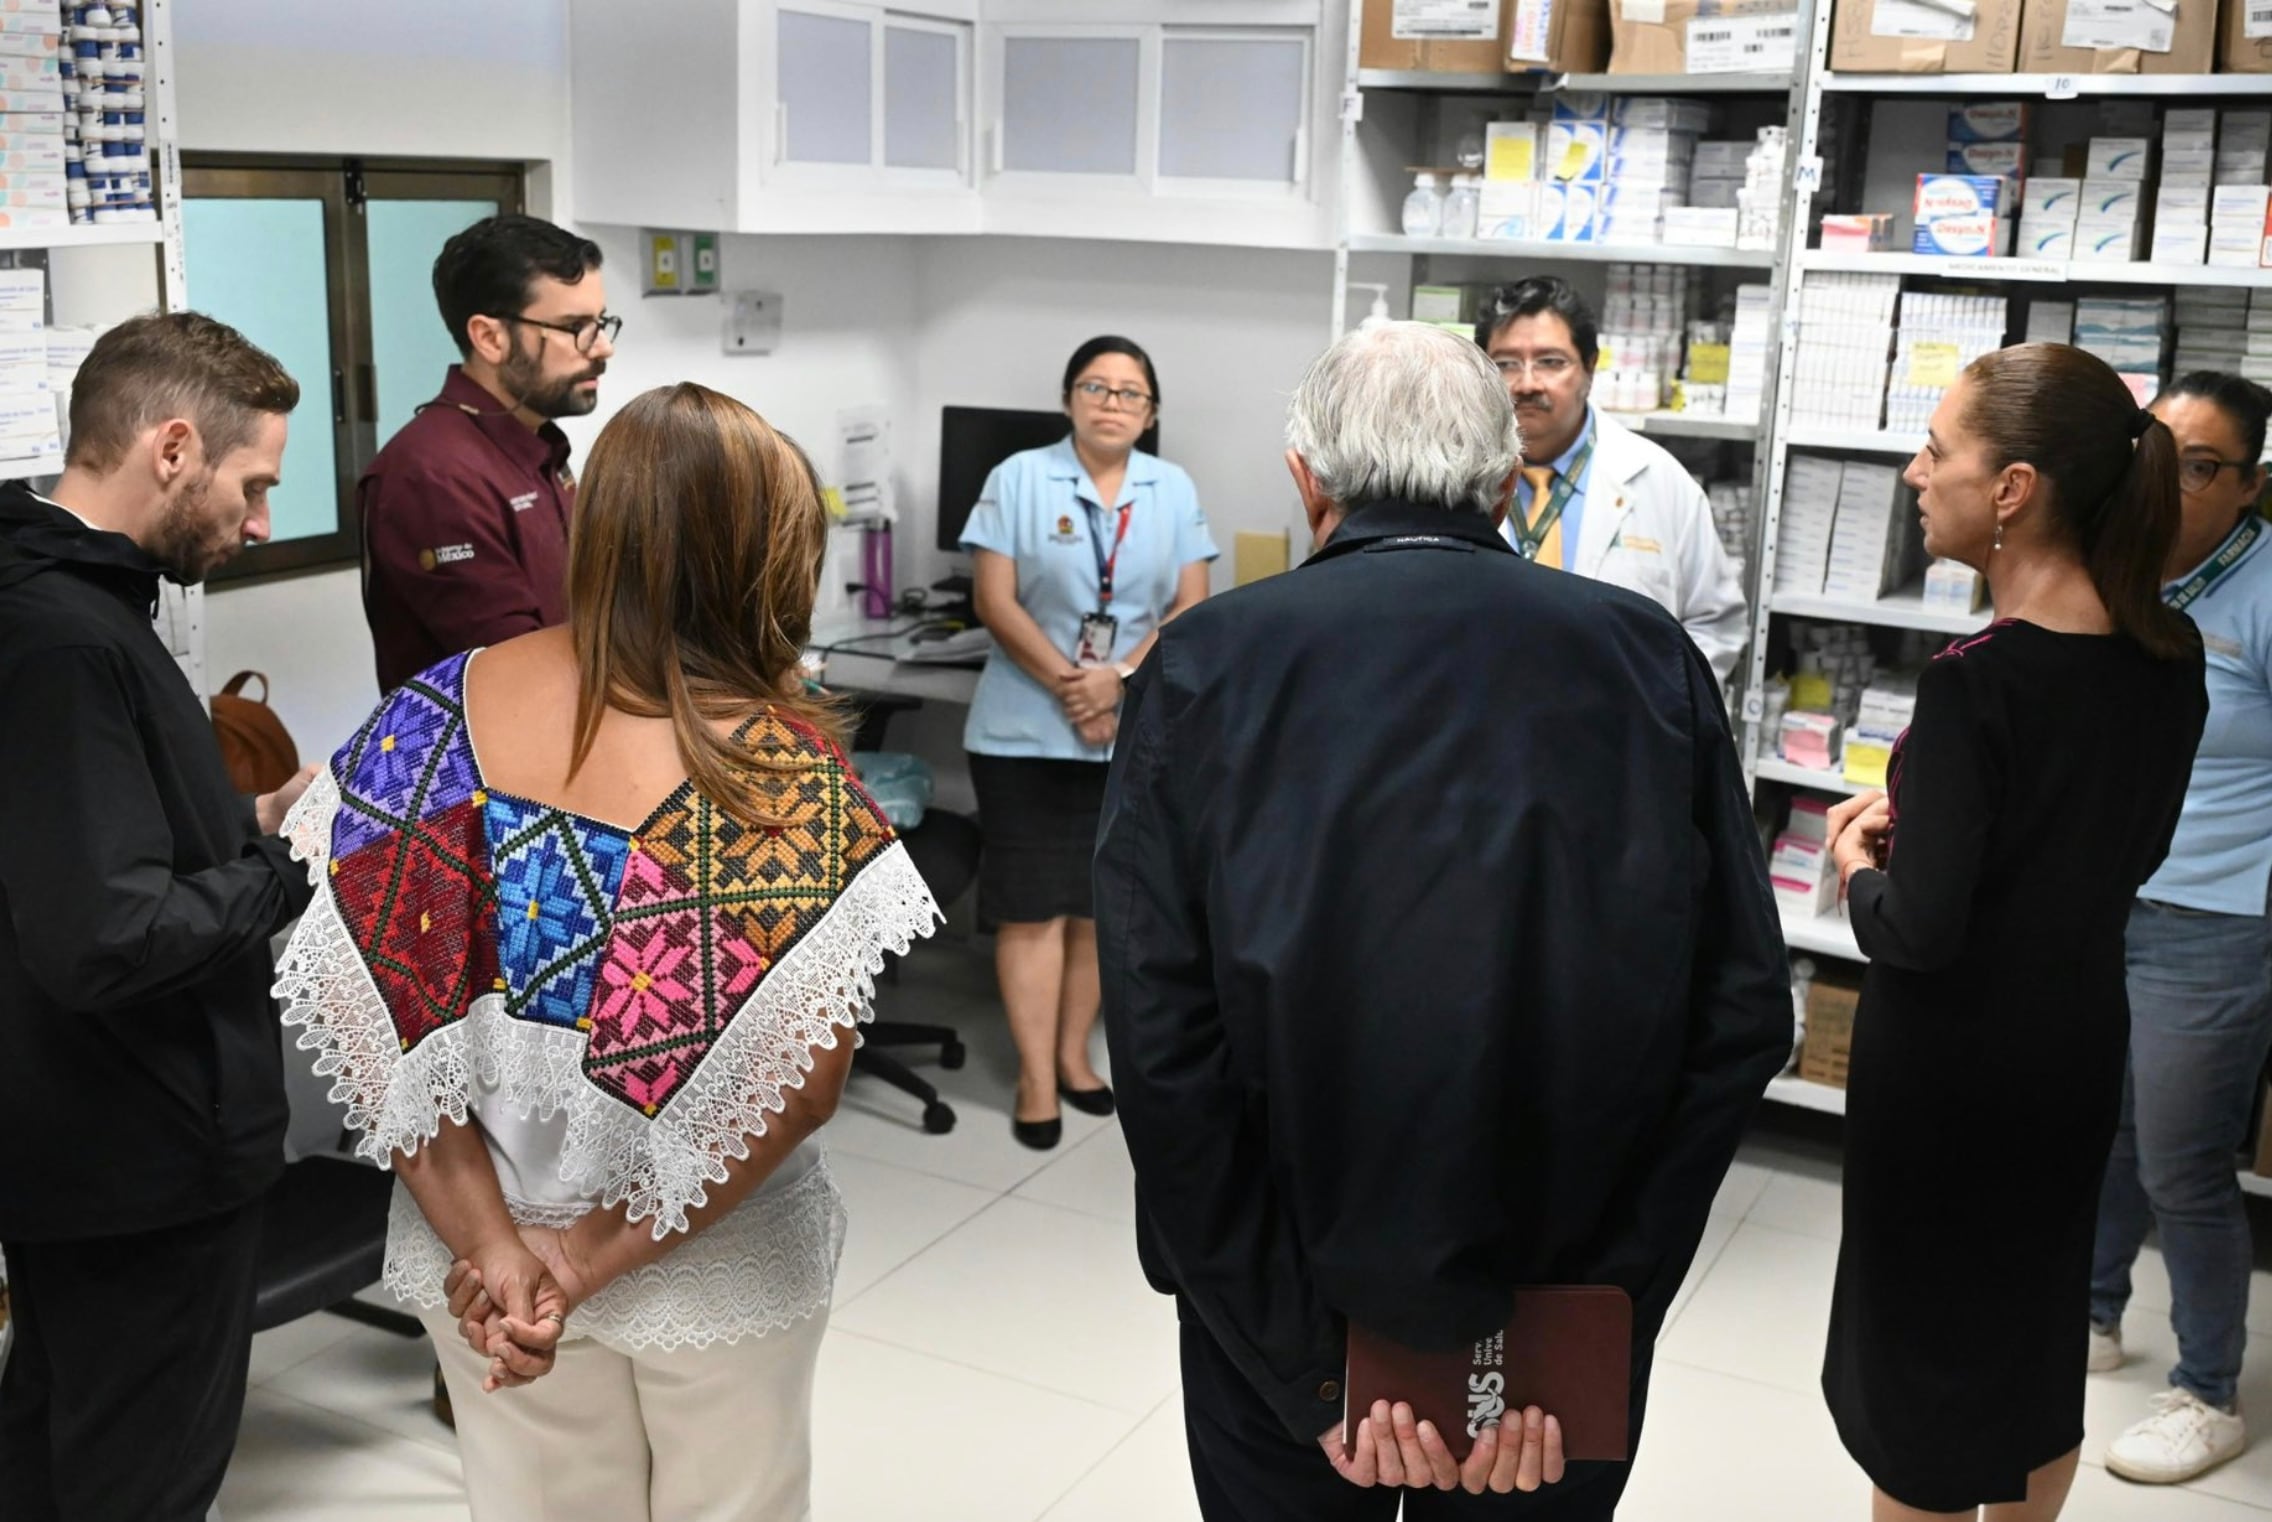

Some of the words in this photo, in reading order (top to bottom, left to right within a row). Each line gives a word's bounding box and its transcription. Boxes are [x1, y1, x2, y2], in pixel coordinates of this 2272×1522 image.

[1396, 535, 1440, 543] NAUTICA
[1473, 1341, 1482, 1365] Serv
[1495, 1353, 1504, 1365] de
